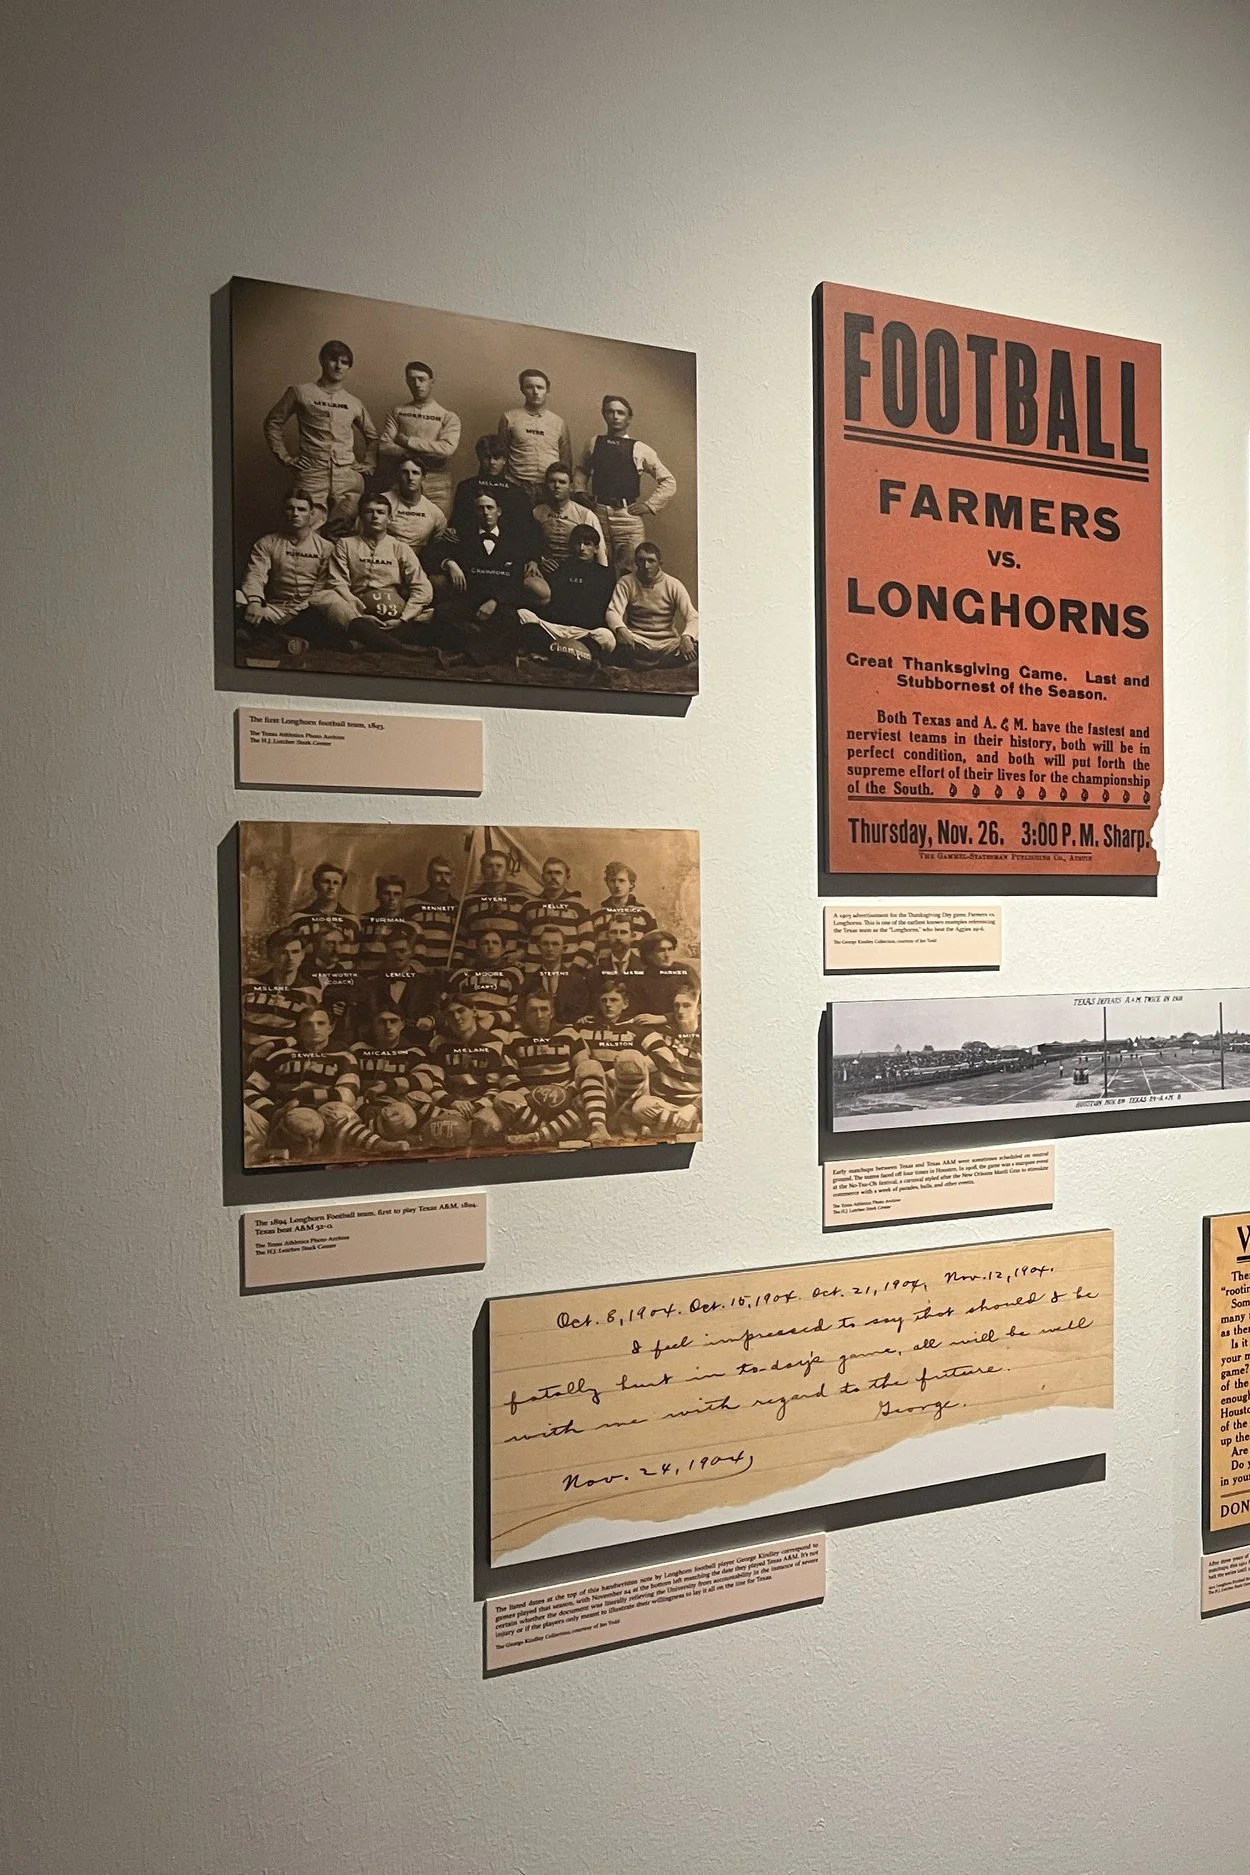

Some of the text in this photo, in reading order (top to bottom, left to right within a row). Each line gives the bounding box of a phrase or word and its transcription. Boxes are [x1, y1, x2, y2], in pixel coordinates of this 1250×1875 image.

[844, 312, 1148, 464] FOOTBALL
[880, 479, 1120, 542] FARMERS
[988, 550, 1020, 569] VS.
[848, 577, 1149, 639] LONGHORNS
[846, 653, 1149, 687] Great Thanksgiving Game. Last and
[897, 674, 1106, 700] Stubbornest of the Season.
[848, 780, 934, 795] of the South.
[848, 818, 1151, 852] Thursday, Nov. 26. 3:00 P. M. Sharp.
